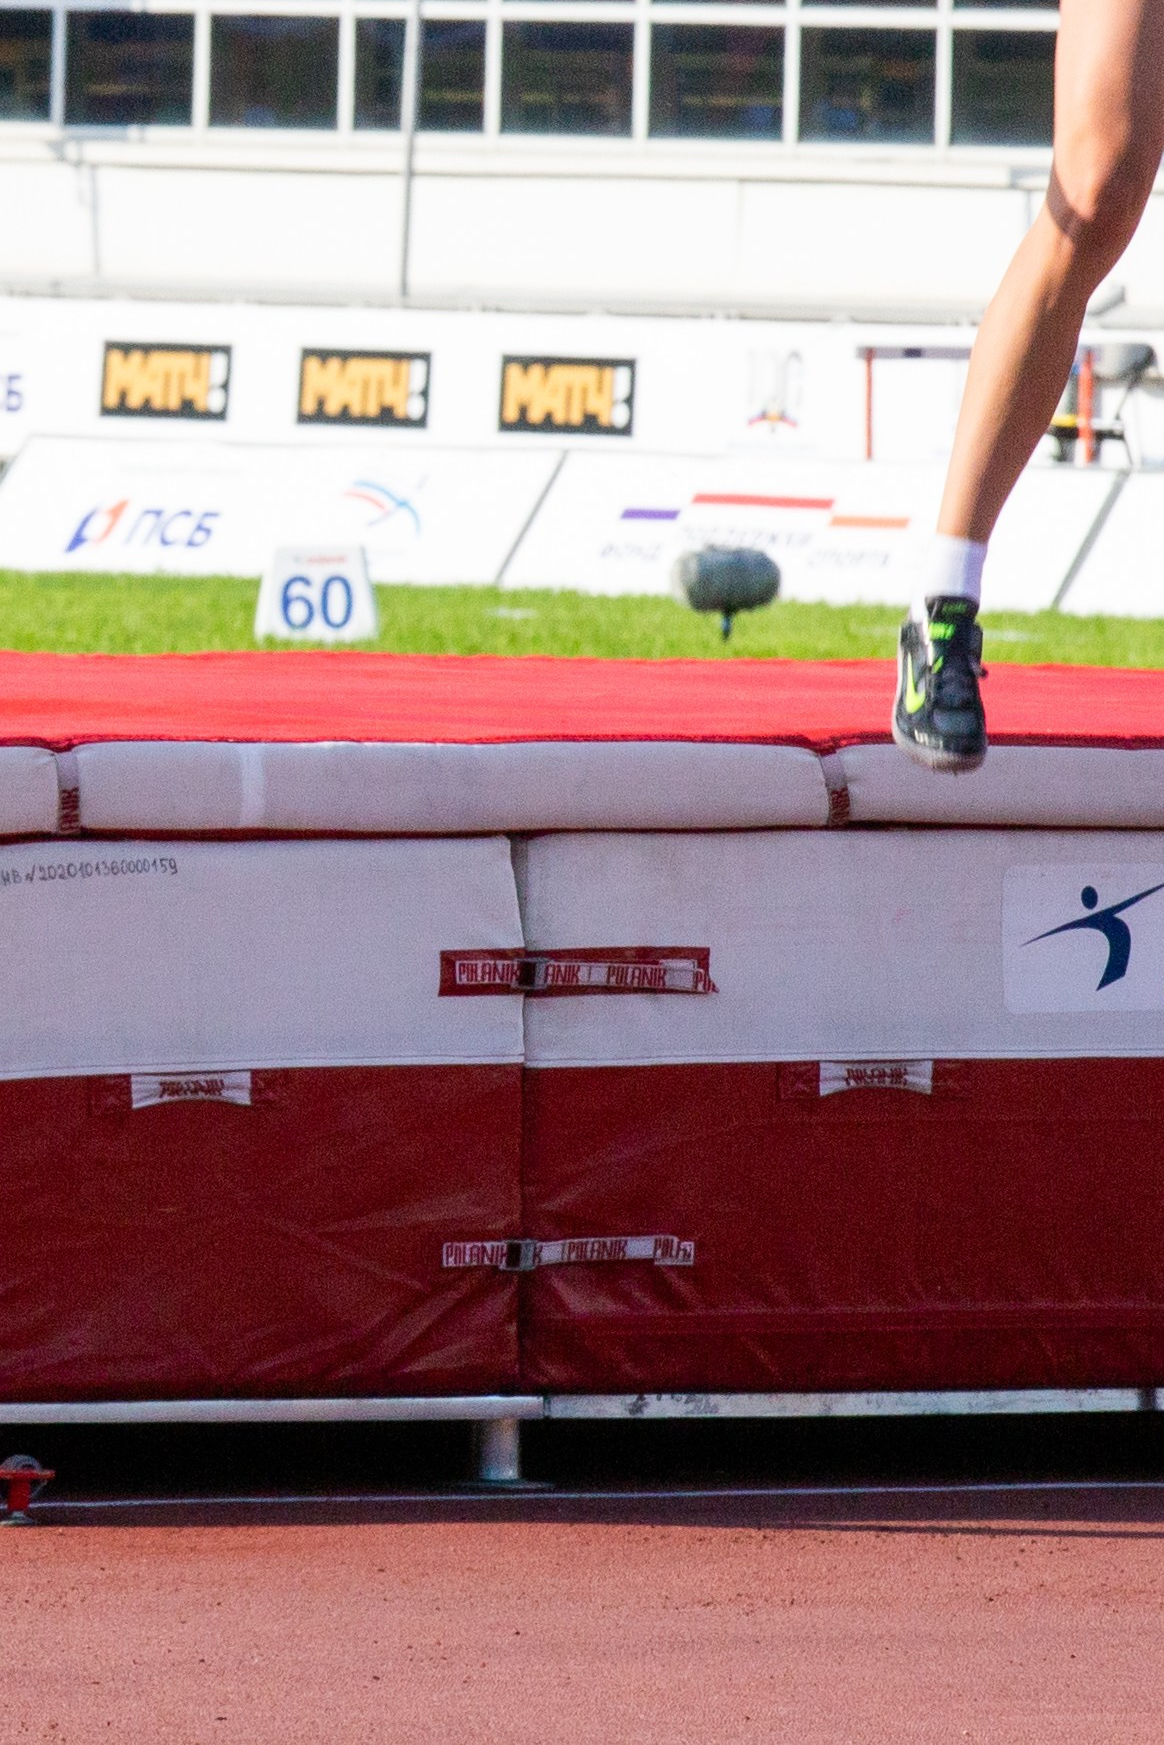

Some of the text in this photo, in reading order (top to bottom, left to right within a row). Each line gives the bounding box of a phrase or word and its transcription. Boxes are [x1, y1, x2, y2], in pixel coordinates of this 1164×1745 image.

[125, 509, 220, 547] ПСБ
[281, 575, 353, 631] 60
[458, 961, 520, 985] POLANIK
[606, 965, 666, 987] POLANIK
